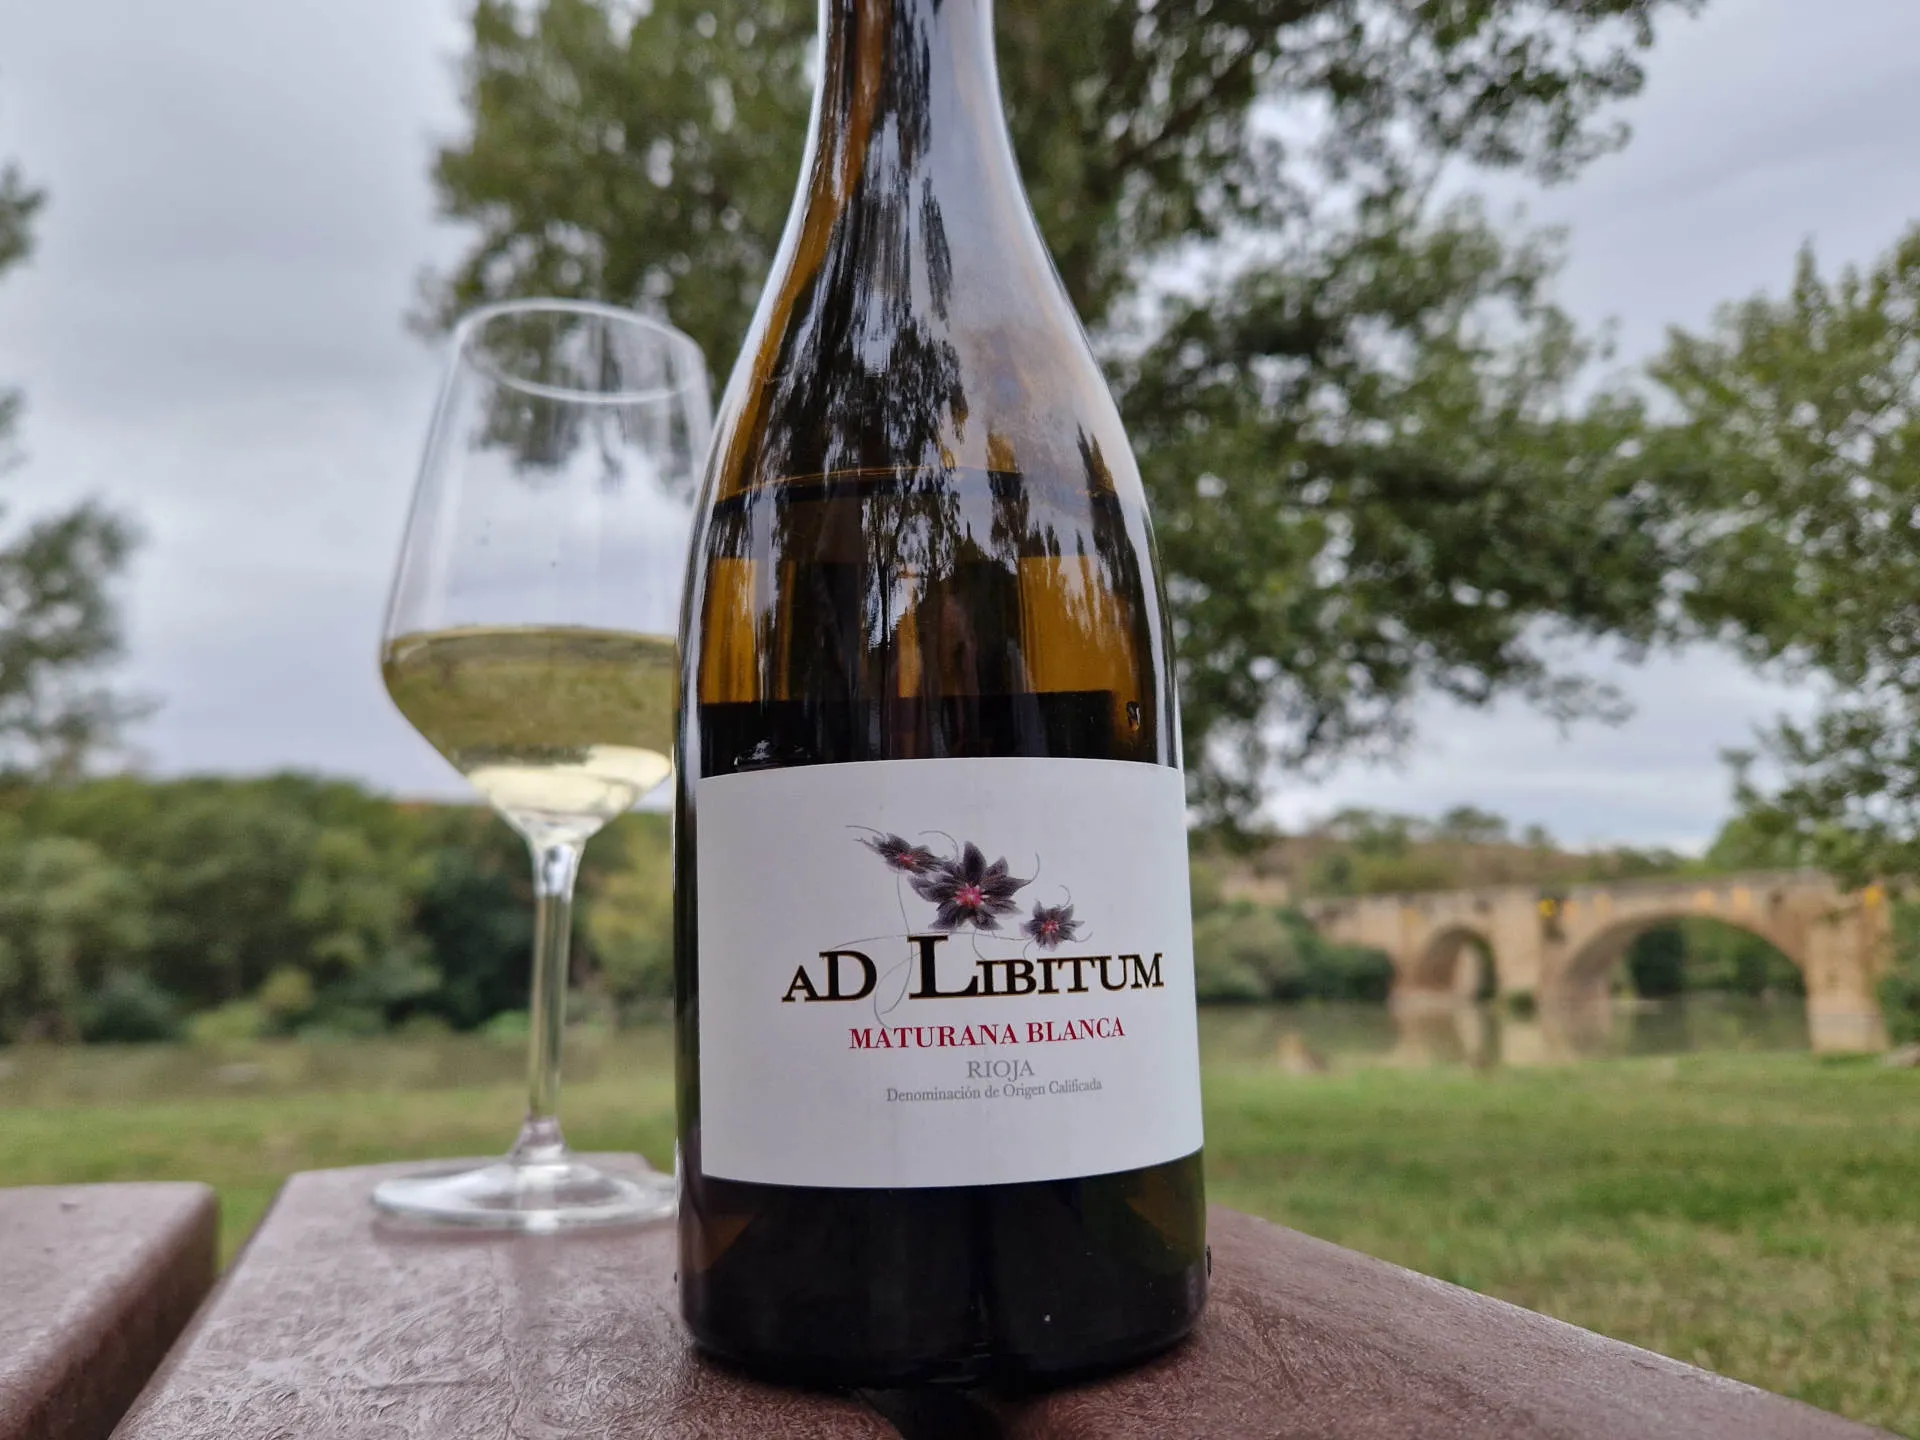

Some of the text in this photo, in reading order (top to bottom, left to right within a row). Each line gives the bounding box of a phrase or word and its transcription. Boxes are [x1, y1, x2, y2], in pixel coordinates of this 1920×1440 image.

[781, 935, 1164, 1002] AD LIBITUM
[848, 1016, 1126, 1049] MATURANA BLANCA
[965, 1059, 1036, 1082] RIOJA
[886, 1077, 1103, 1103] Denominación de Origen Calificada
